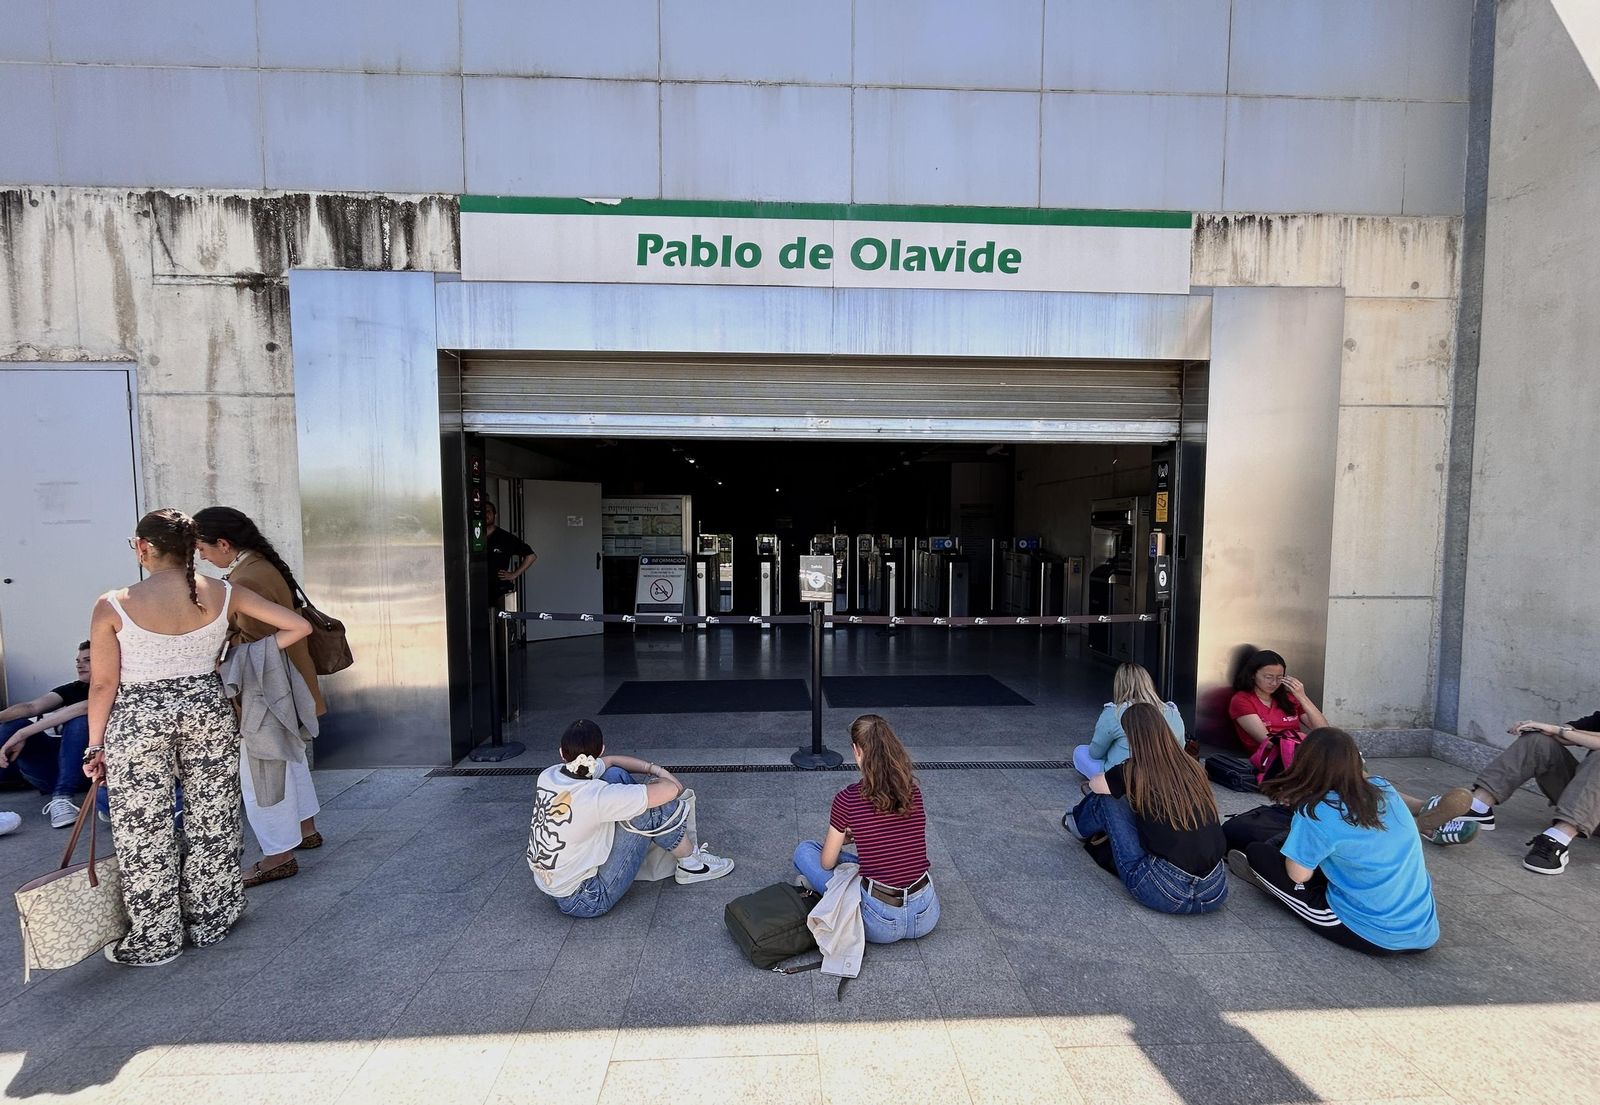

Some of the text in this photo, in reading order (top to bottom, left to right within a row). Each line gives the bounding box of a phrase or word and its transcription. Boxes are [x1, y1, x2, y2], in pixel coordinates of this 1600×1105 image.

[636, 233, 1022, 273] Pablo de Olavide
